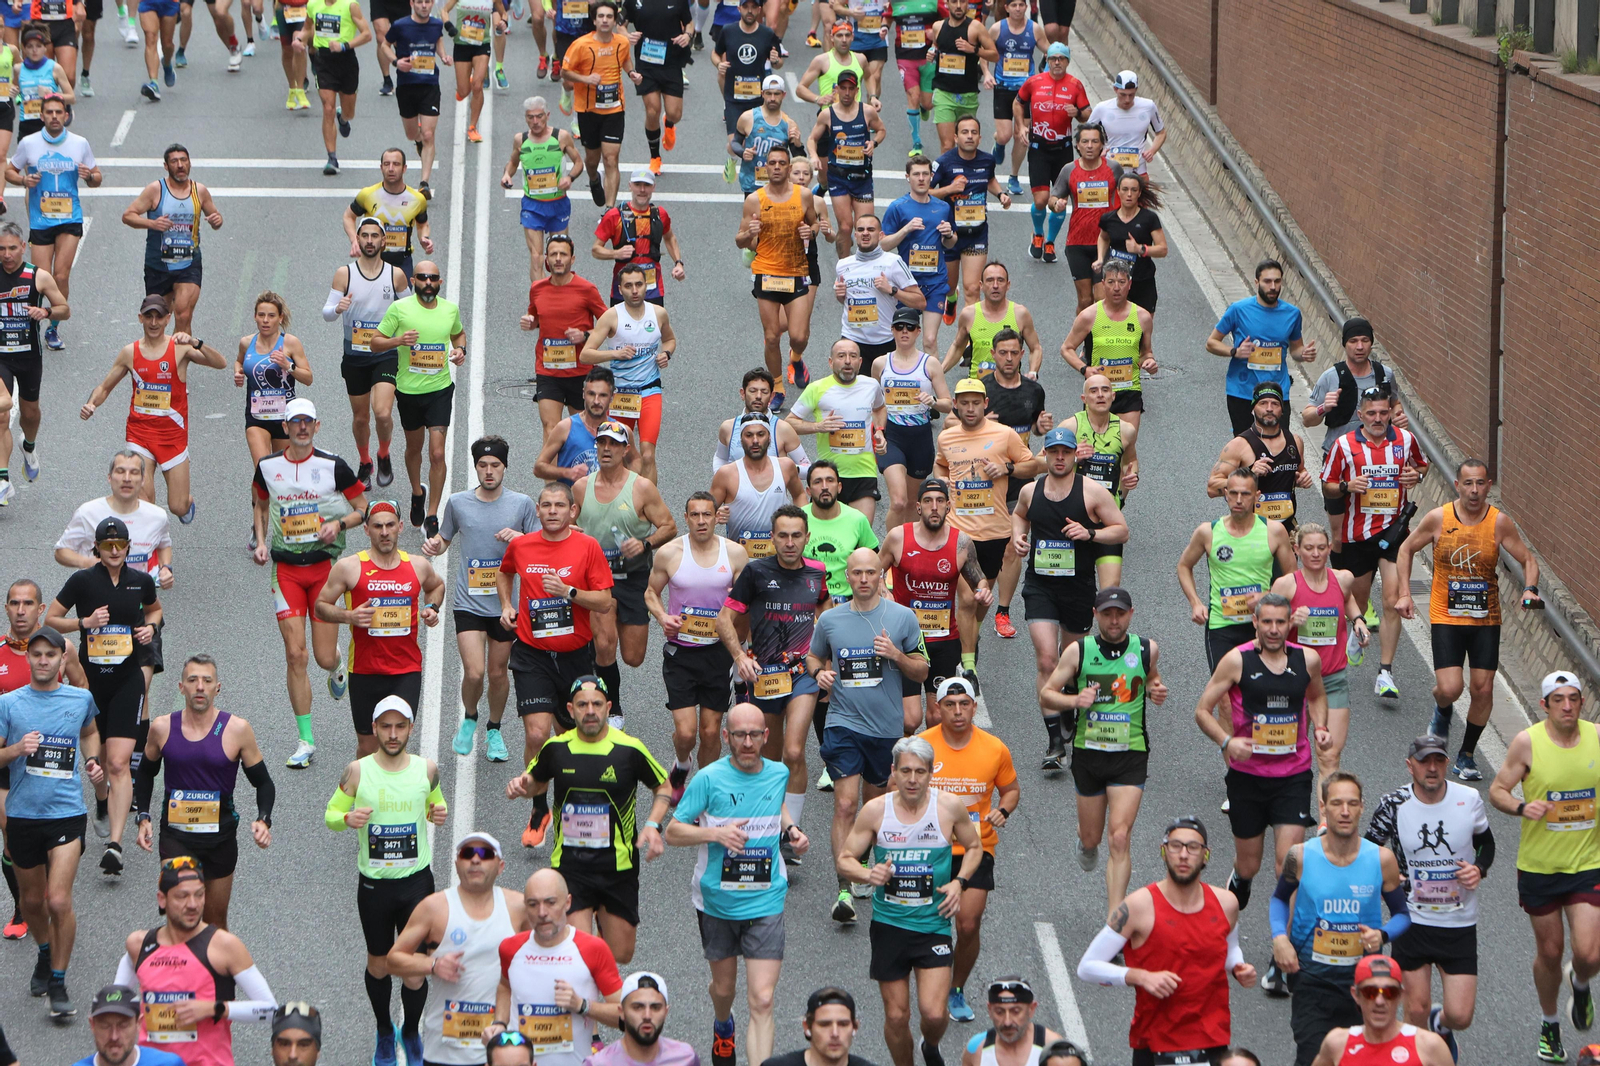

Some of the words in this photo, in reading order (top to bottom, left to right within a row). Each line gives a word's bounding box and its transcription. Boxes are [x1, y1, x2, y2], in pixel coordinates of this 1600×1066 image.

[534, 167, 553, 175] ZURICH
[1116, 251, 1134, 260] ZURICH
[362, 321, 380, 329] ZURIC
[1115, 337, 1132, 345] Rota
[422, 343, 443, 351] ZURICH
[1109, 358, 1131, 366] ZURICH
[145, 382, 168, 391] ZURICH
[620, 387, 639, 395] ZURICH
[261, 399, 275, 407] 7747
[840, 432, 855, 440] 4487
[1362, 466, 1399, 476] Plus500
[966, 481, 989, 489] ZURICH
[1374, 481, 1396, 489] ZURICH
[1373, 492, 1388, 500] 4513
[291, 506, 315, 514] ZURICH
[1267, 504, 1281, 512] 5703
[751, 531, 772, 540] ZURIC
[1047, 540, 1071, 549] ZURICH
[125, 554, 144, 563] URICH
[1047, 552, 1062, 560] 1590
[367, 583, 403, 592] OZONO
[912, 579, 950, 591] LAWDE
[1233, 584, 1259, 595] ZURICH
[1462, 581, 1485, 589] ZURICH
[382, 596, 408, 605] ZURICH
[541, 598, 567, 607] ZURICH
[924, 601, 947, 609] ZURICH
[765, 601, 783, 611] CLUB
[783, 602, 792, 611] DE
[382, 611, 398, 619] 4755
[695, 607, 718, 617] ZURICH
[1312, 608, 1336, 616] ZURICH
[922, 613, 938, 622] 4848
[693, 620, 709, 629] 4674
[102, 626, 127, 634] ZURICH
[102, 639, 118, 647] 4486
[763, 664, 786, 673] ZURICH
[852, 661, 868, 670] 2285
[764, 678, 780, 687] 6070
[764, 687, 780, 695] PEDRO
[1100, 713, 1126, 722] ZURICH
[1269, 715, 1294, 724] ZURICH
[1099, 726, 1116, 735] 1843
[1268, 728, 1285, 737] 4244
[47, 736, 73, 746] ZURICH
[1096, 735, 1118, 744] GUZMAN
[43, 749, 62, 759] 3313
[44, 760, 59, 769] NIÑO
[969, 784, 987, 794] 2018
[186, 790, 214, 800] ZURICH
[1563, 789, 1592, 800] ZURICH
[185, 805, 203, 814] 3697
[577, 805, 604, 815] ZURICH
[1563, 804, 1581, 813] 5023
[384, 826, 412, 835] ZURICH
[383, 840, 402, 850] 3471
[383, 851, 404, 860] BORJA
[883, 849, 932, 862] ATLEET
[738, 863, 756, 873] 3245
[899, 865, 928, 874] ZURICH
[738, 874, 755, 882] JUAN
[898, 879, 917, 889] 3443
[896, 890, 921, 898] ANTONIO
[1430, 885, 1448, 895] 7142
[1323, 898, 1361, 915] DUXO
[1331, 921, 1361, 931] ZURICH
[1330, 937, 1349, 947] 4106
[525, 954, 573, 962] WONG
[157, 992, 190, 1002] ZURICH
[157, 1010, 176, 1019] 4612
[460, 1018, 481, 1028] 4533
[534, 1022, 553, 1032] 6097
[1174, 1055, 1192, 1065] ALEX
